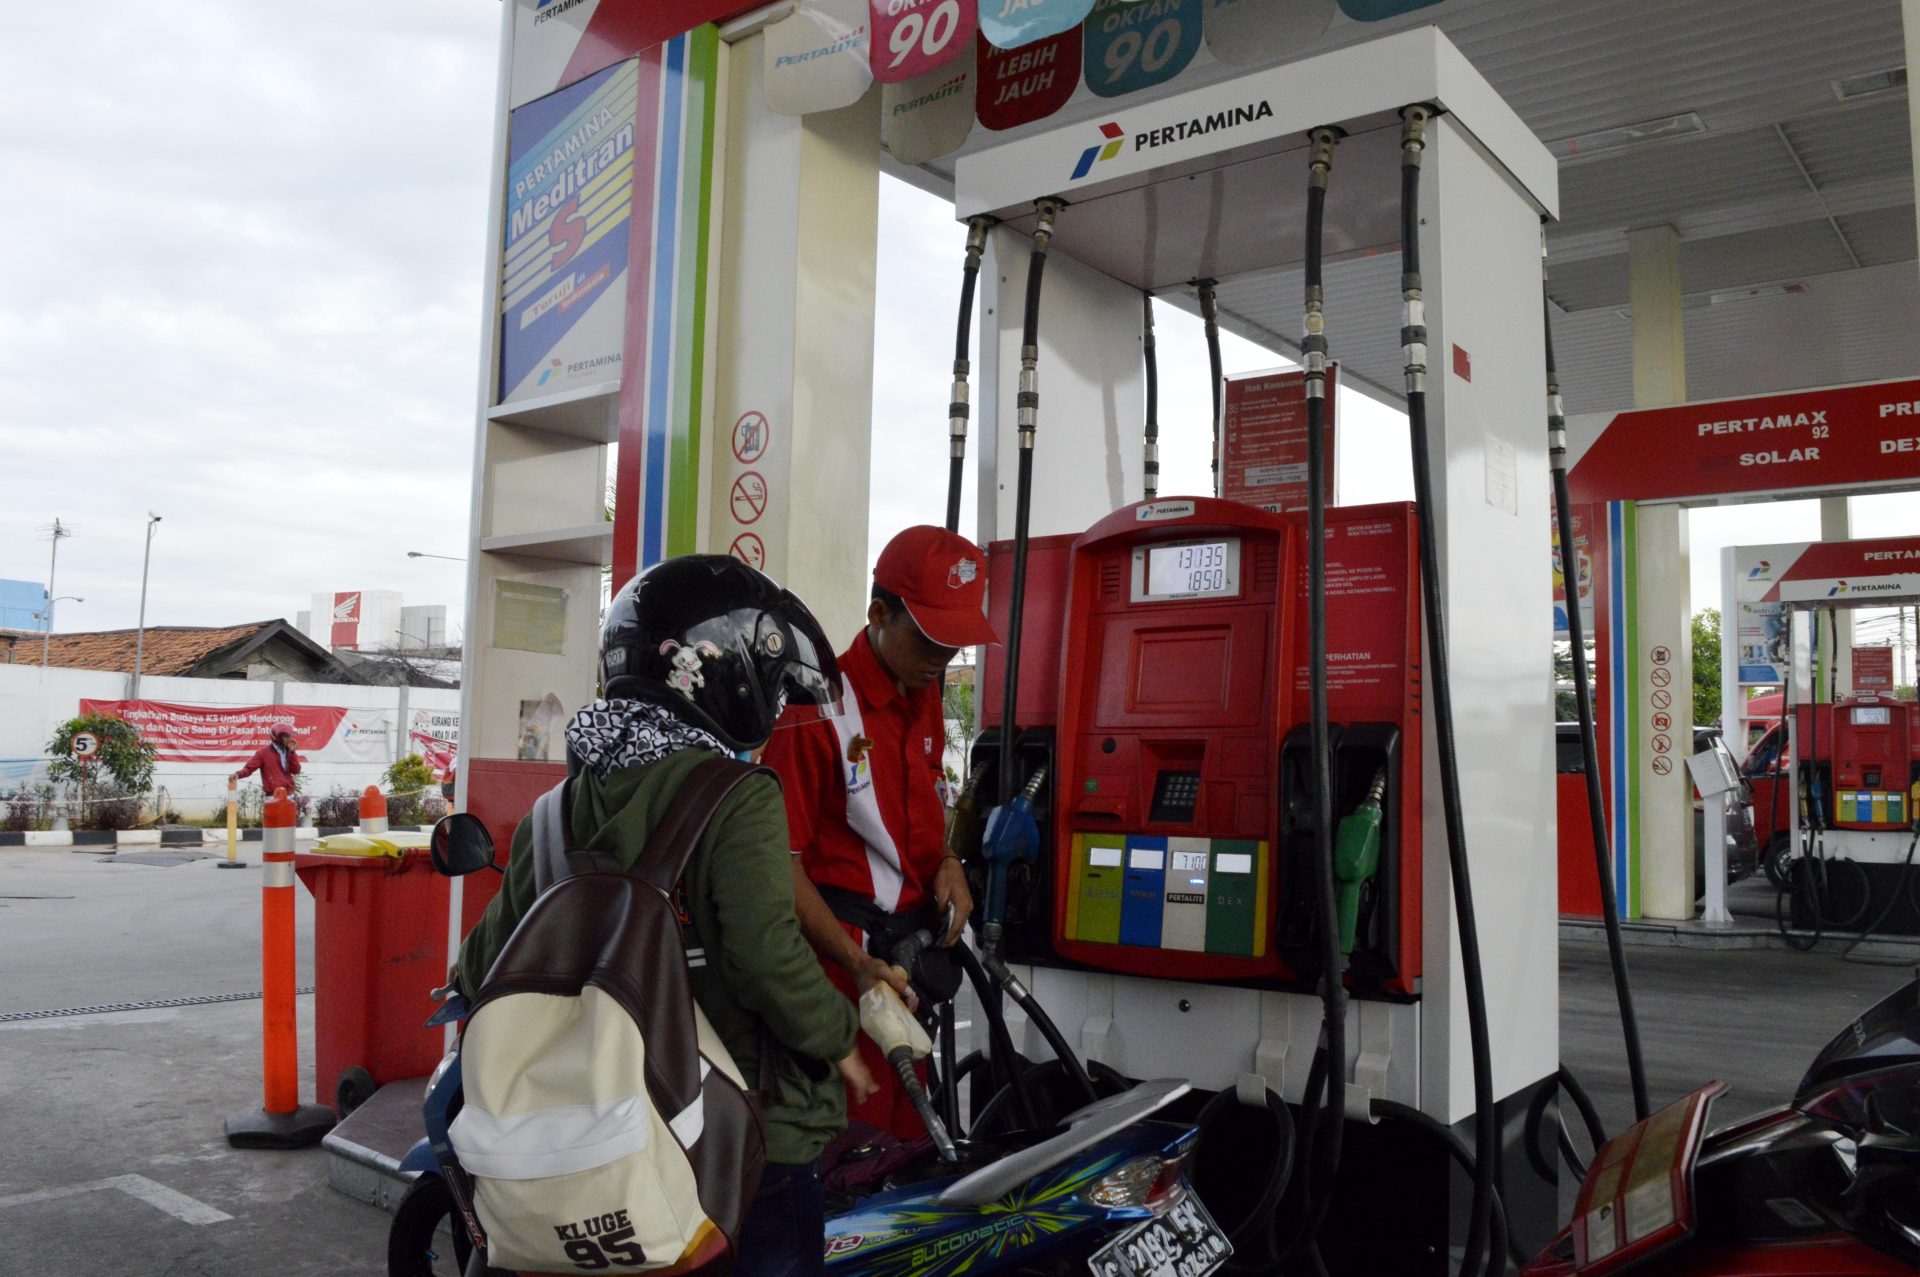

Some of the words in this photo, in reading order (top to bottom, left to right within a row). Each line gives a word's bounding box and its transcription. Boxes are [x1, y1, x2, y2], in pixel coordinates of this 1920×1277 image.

[888, 0, 960, 69] 90
[774, 38, 864, 69] PERTALITE
[996, 43, 1058, 80] LEBIH
[1104, 18, 1182, 84] 90
[893, 82, 965, 117] PERTALITE
[993, 69, 1056, 105] JAUH
[1135, 100, 1274, 152] PERTAMINA
[515, 107, 614, 199] PERTAMINA
[511, 122, 634, 241] Meditran
[548, 194, 587, 273] S
[567, 352, 622, 374] PERTAMINA
[1697, 410, 1828, 437] PERTAMAX
[1811, 425, 1830, 440] 92
[1739, 446, 1820, 466] SOLAR
[1156, 506, 1189, 514] PERTAMINA
[1178, 546, 1223, 569] 13135
[1851, 583, 1902, 592] PERTAMINA
[146, 723, 163, 732] dan
[166, 725, 189, 735] Daya
[191, 726, 216, 736] Saing
[230, 726, 255, 735] Pasar
[170, 713, 204, 723] Budaya
[220, 715, 246, 723] Untuk
[249, 715, 295, 725] Mendorong
[76, 738, 88, 751] 5
[1168, 895, 1204, 903] PERTALITE
[553, 1208, 632, 1241] KLUGE
[563, 1226, 647, 1269] 95
